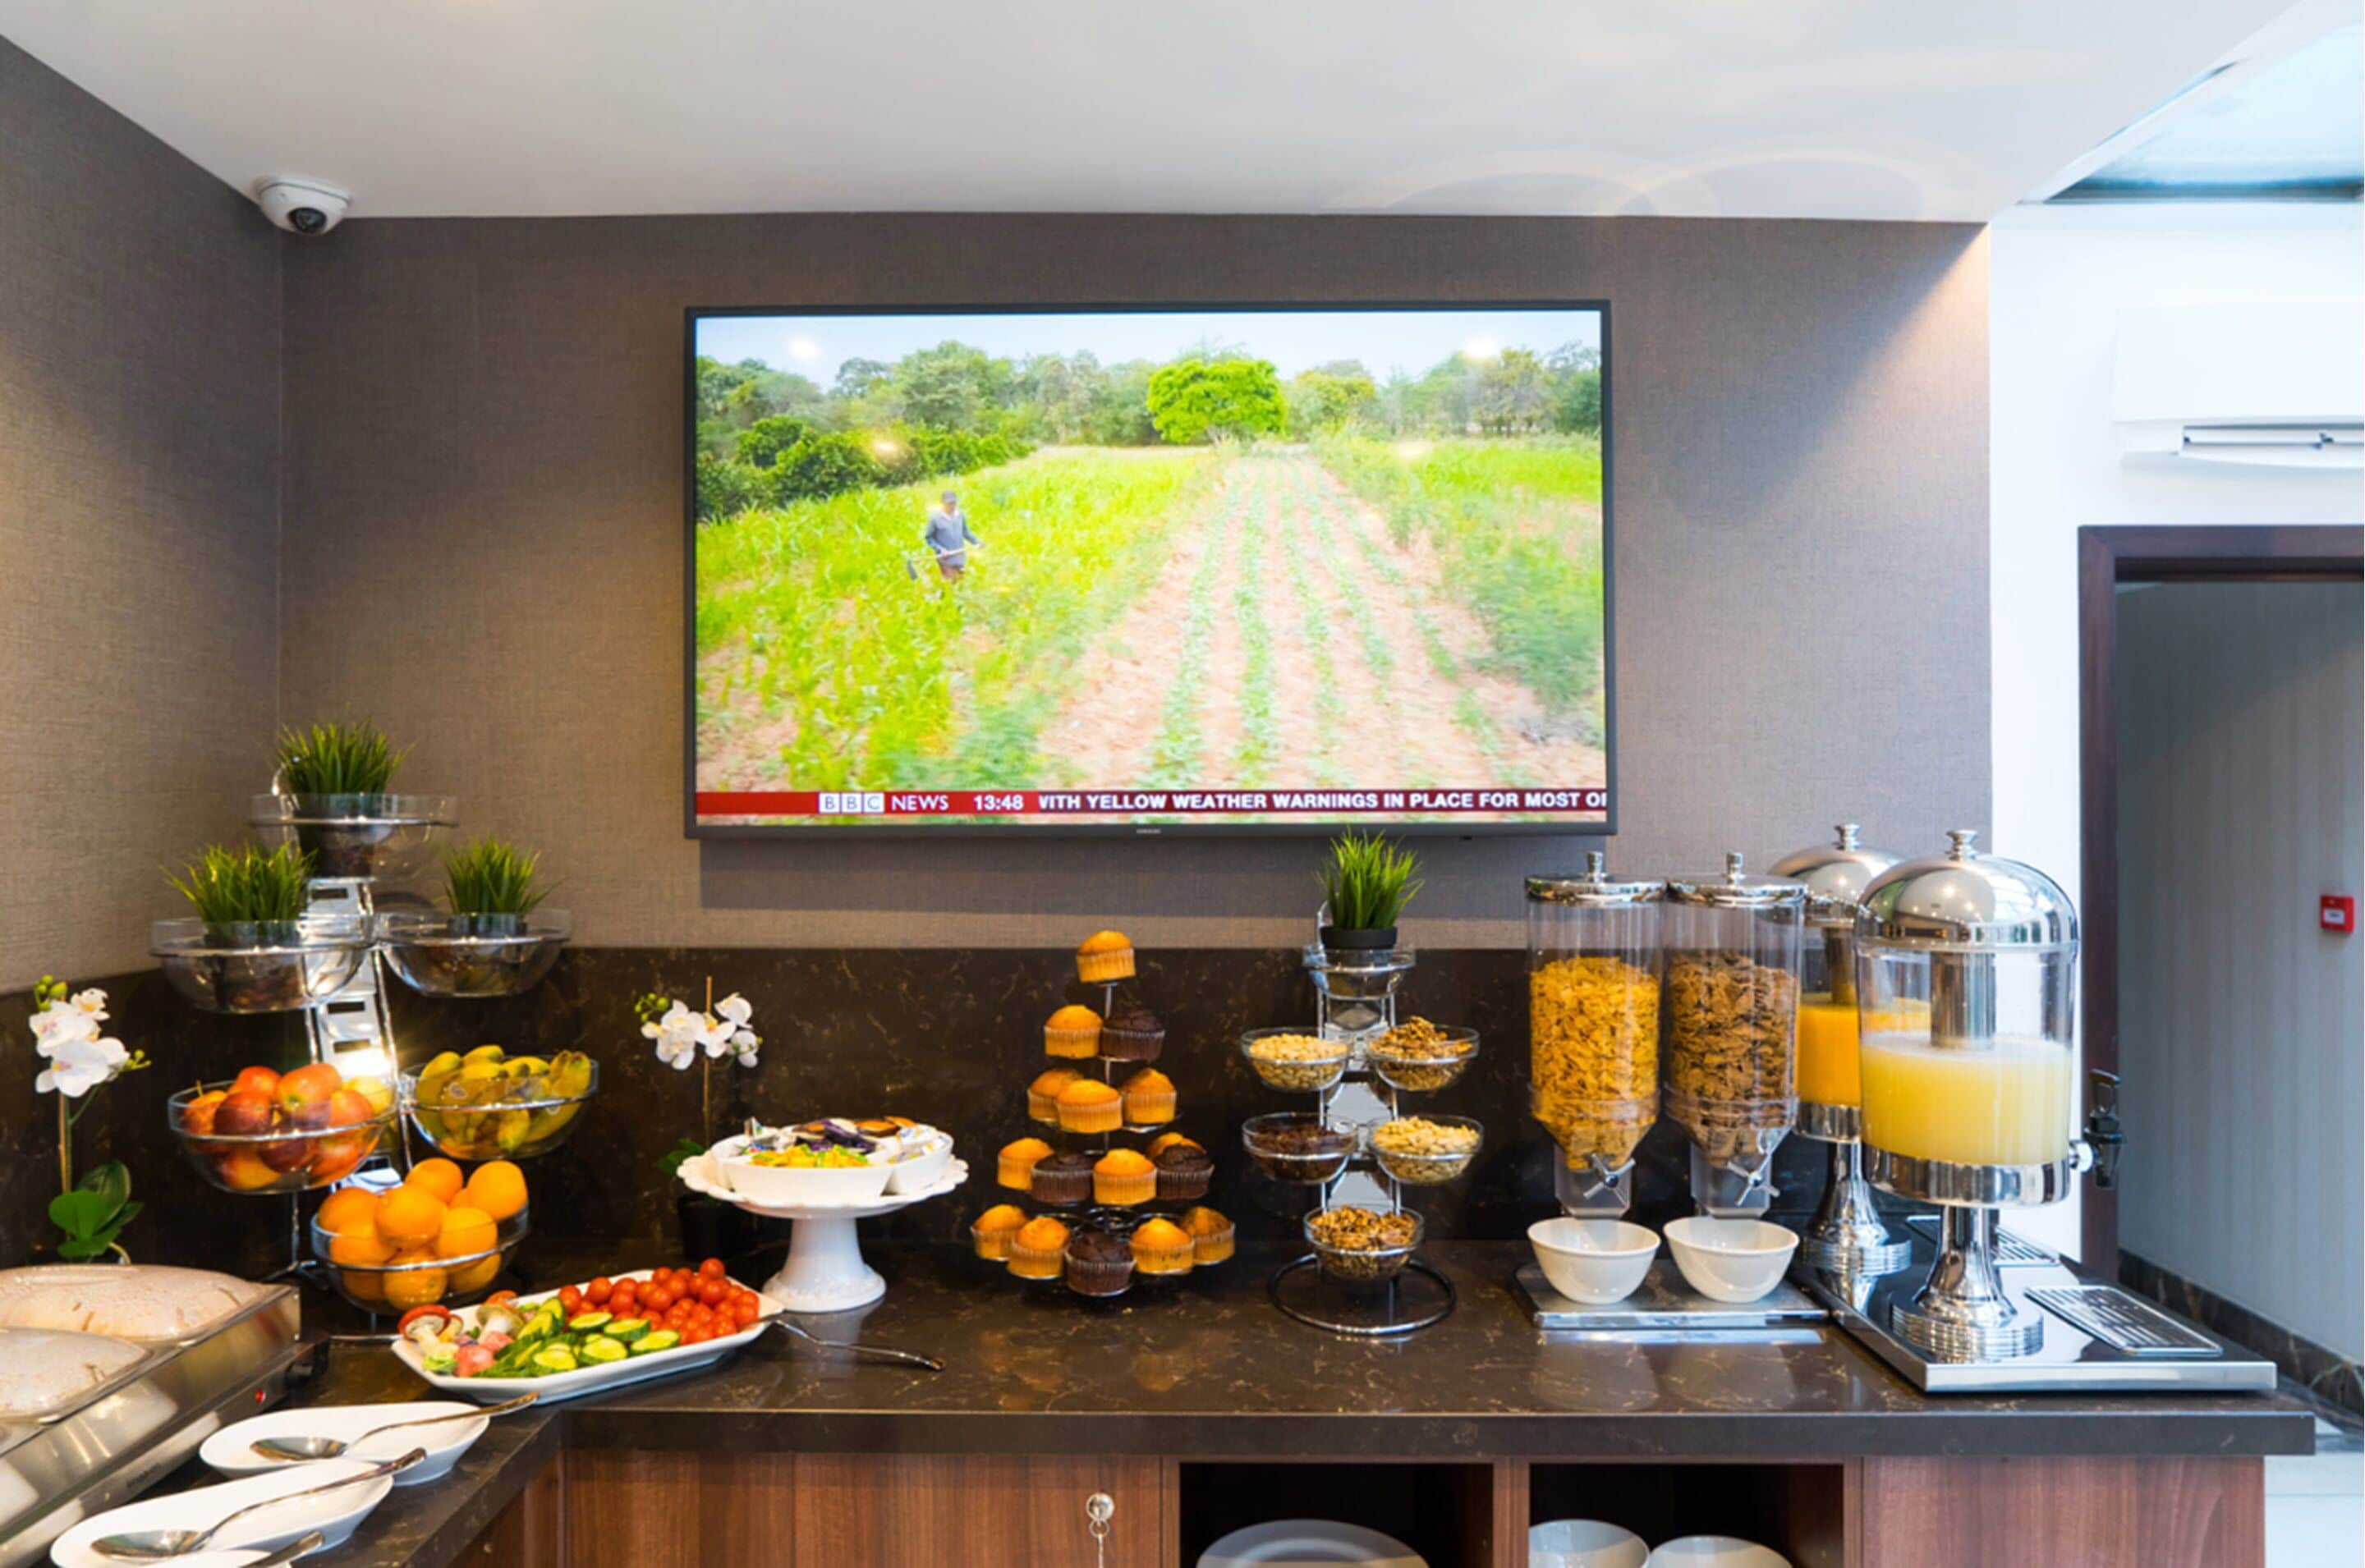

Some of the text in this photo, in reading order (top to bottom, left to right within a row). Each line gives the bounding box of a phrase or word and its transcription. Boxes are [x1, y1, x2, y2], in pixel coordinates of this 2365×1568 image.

[824, 795, 949, 811] BBC NEWS
[973, 795, 1024, 810] 13:48
[1086, 795, 1166, 809] YELLOW
[1172, 794, 1267, 809] WEATHER
[1273, 793, 1379, 809] WARNINGS
[1384, 793, 1404, 808] IN
[1409, 793, 1474, 808] PLACE
[1480, 793, 1519, 808] FOR
[1525, 792, 1581, 808] MOST
